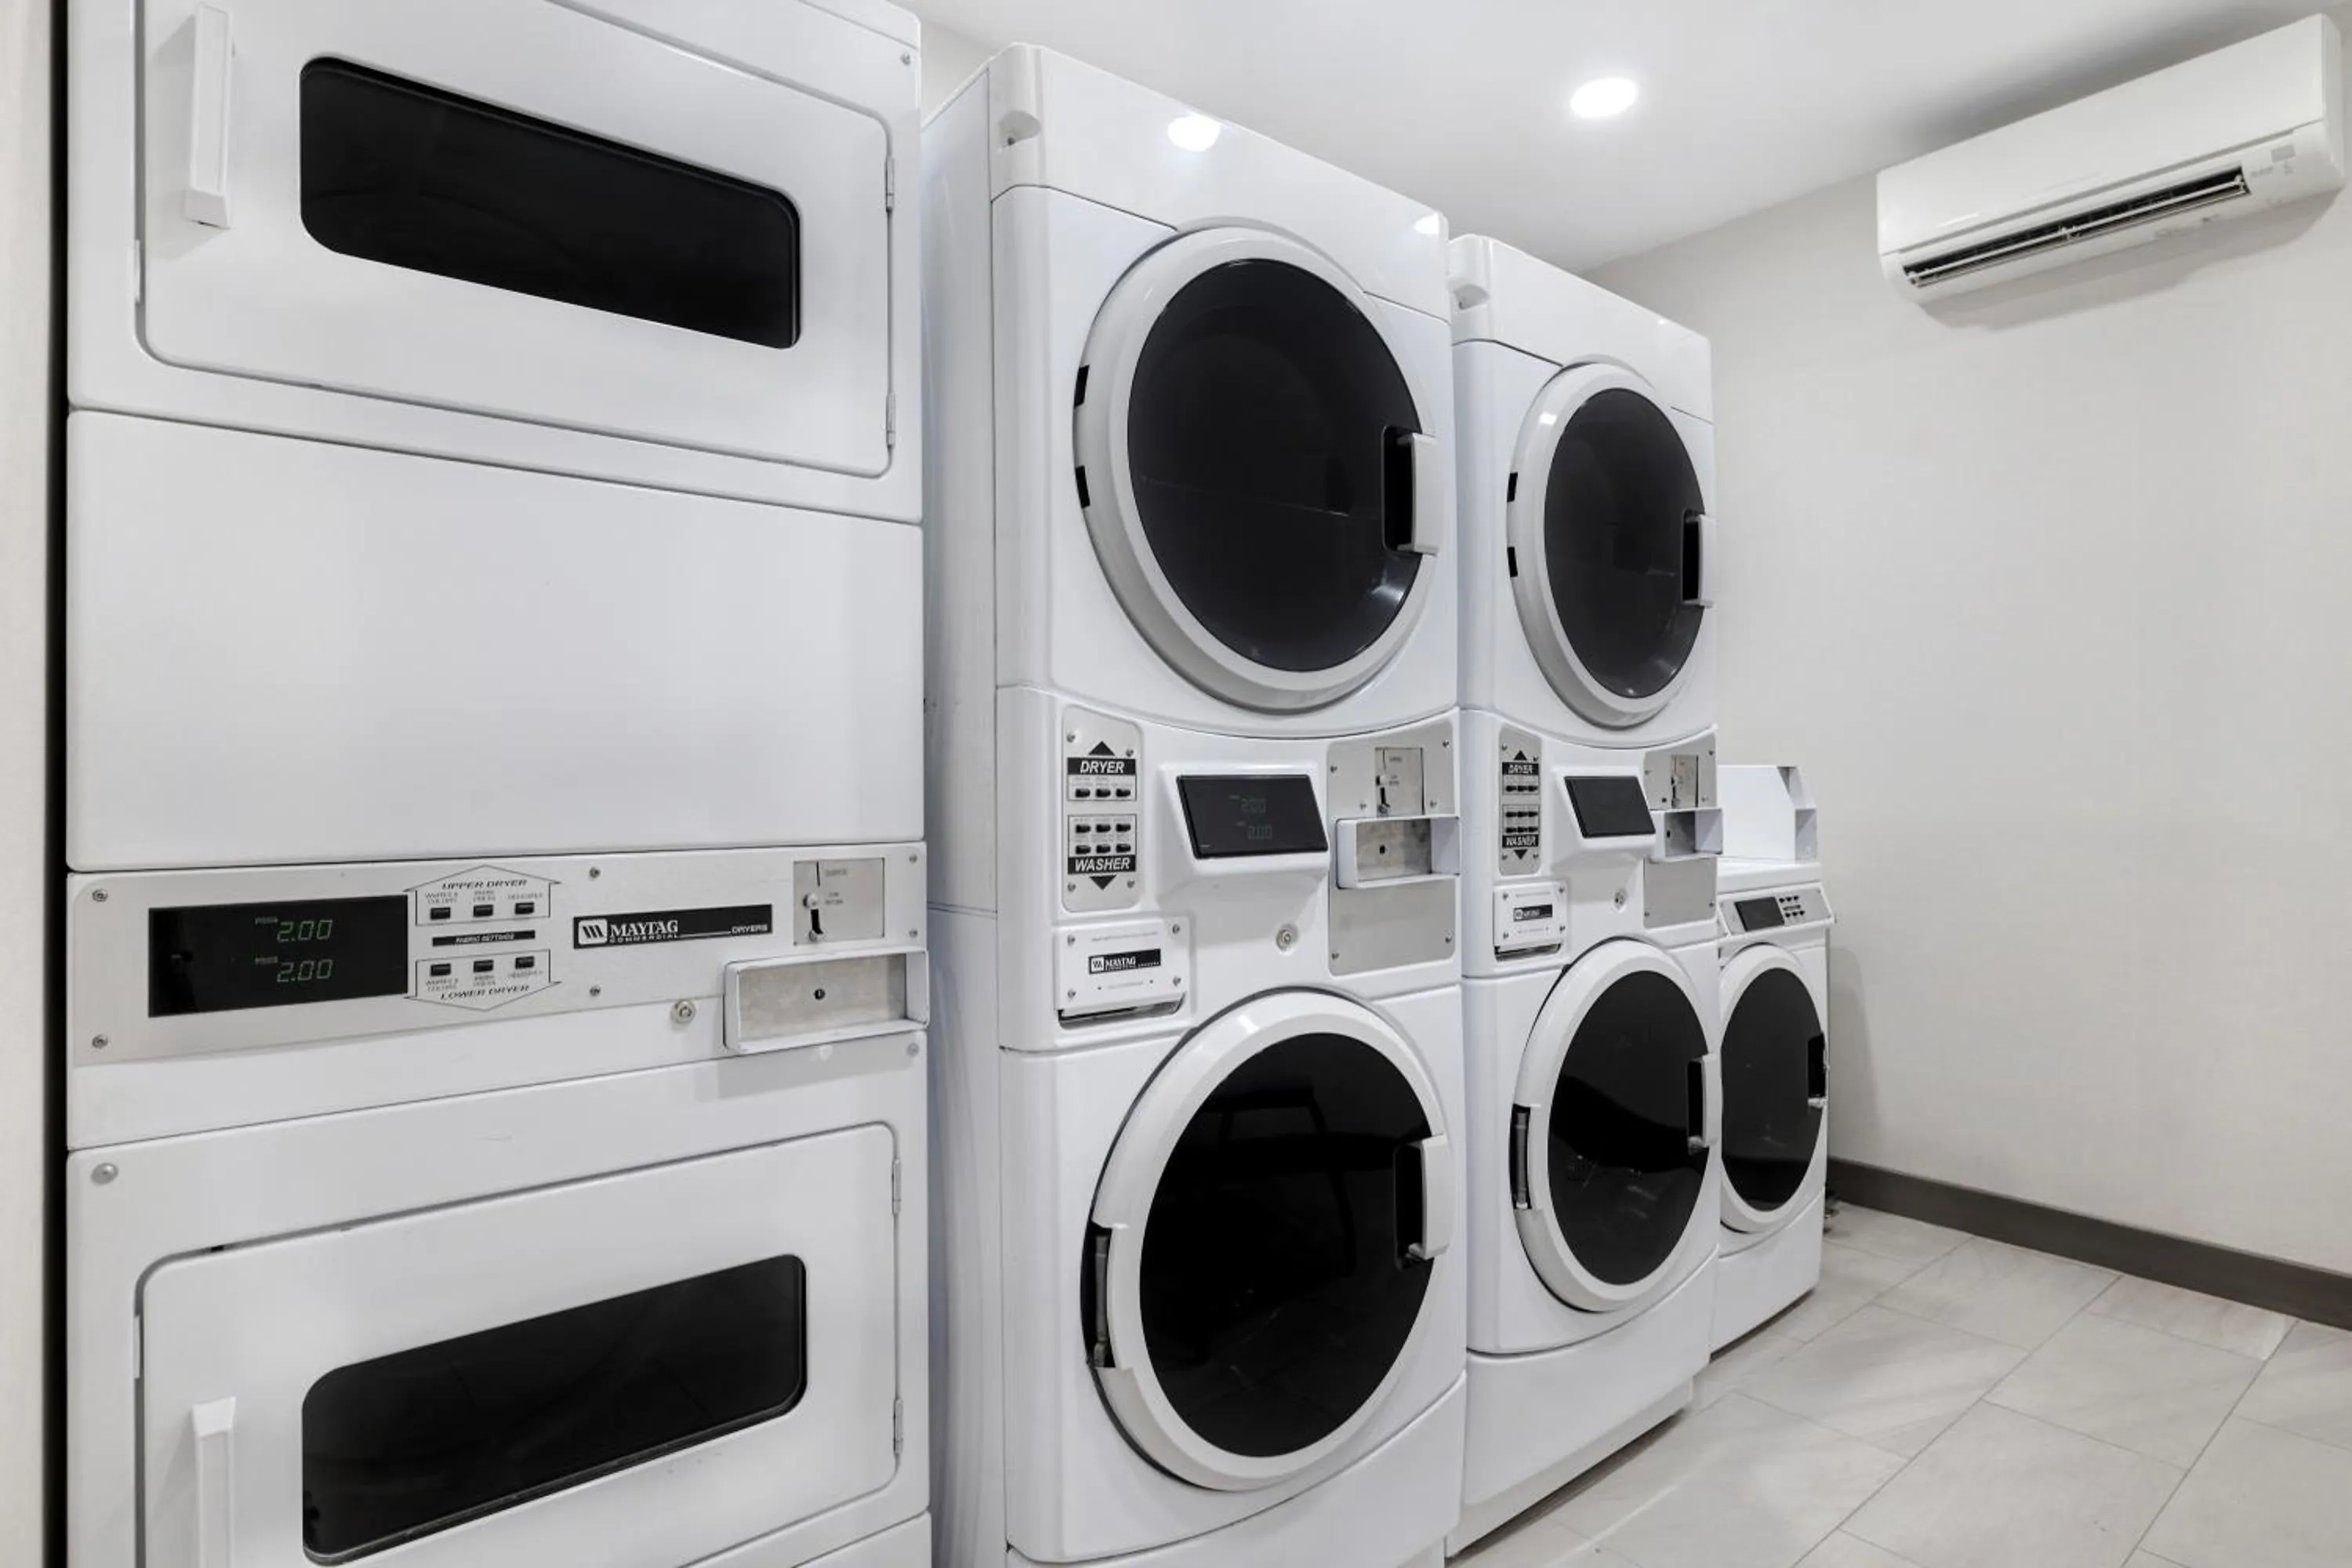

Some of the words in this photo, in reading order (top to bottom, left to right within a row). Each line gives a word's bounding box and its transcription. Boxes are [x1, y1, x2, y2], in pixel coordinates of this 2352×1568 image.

[1080, 760, 1125, 774] DRYER
[1075, 857, 1131, 872] WASHER
[441, 880, 485, 890] UPPER
[486, 878, 528, 888] DRYER
[276, 919, 334, 943] 2.00
[609, 920, 679, 938] MAYTAG
[731, 924, 768, 935] DRYERS
[609, 933, 678, 943] COMMERCIAL
[276, 958, 334, 983] 2.00
[440, 989, 486, 1000] LOWER
[488, 984, 530, 996] DRYER
